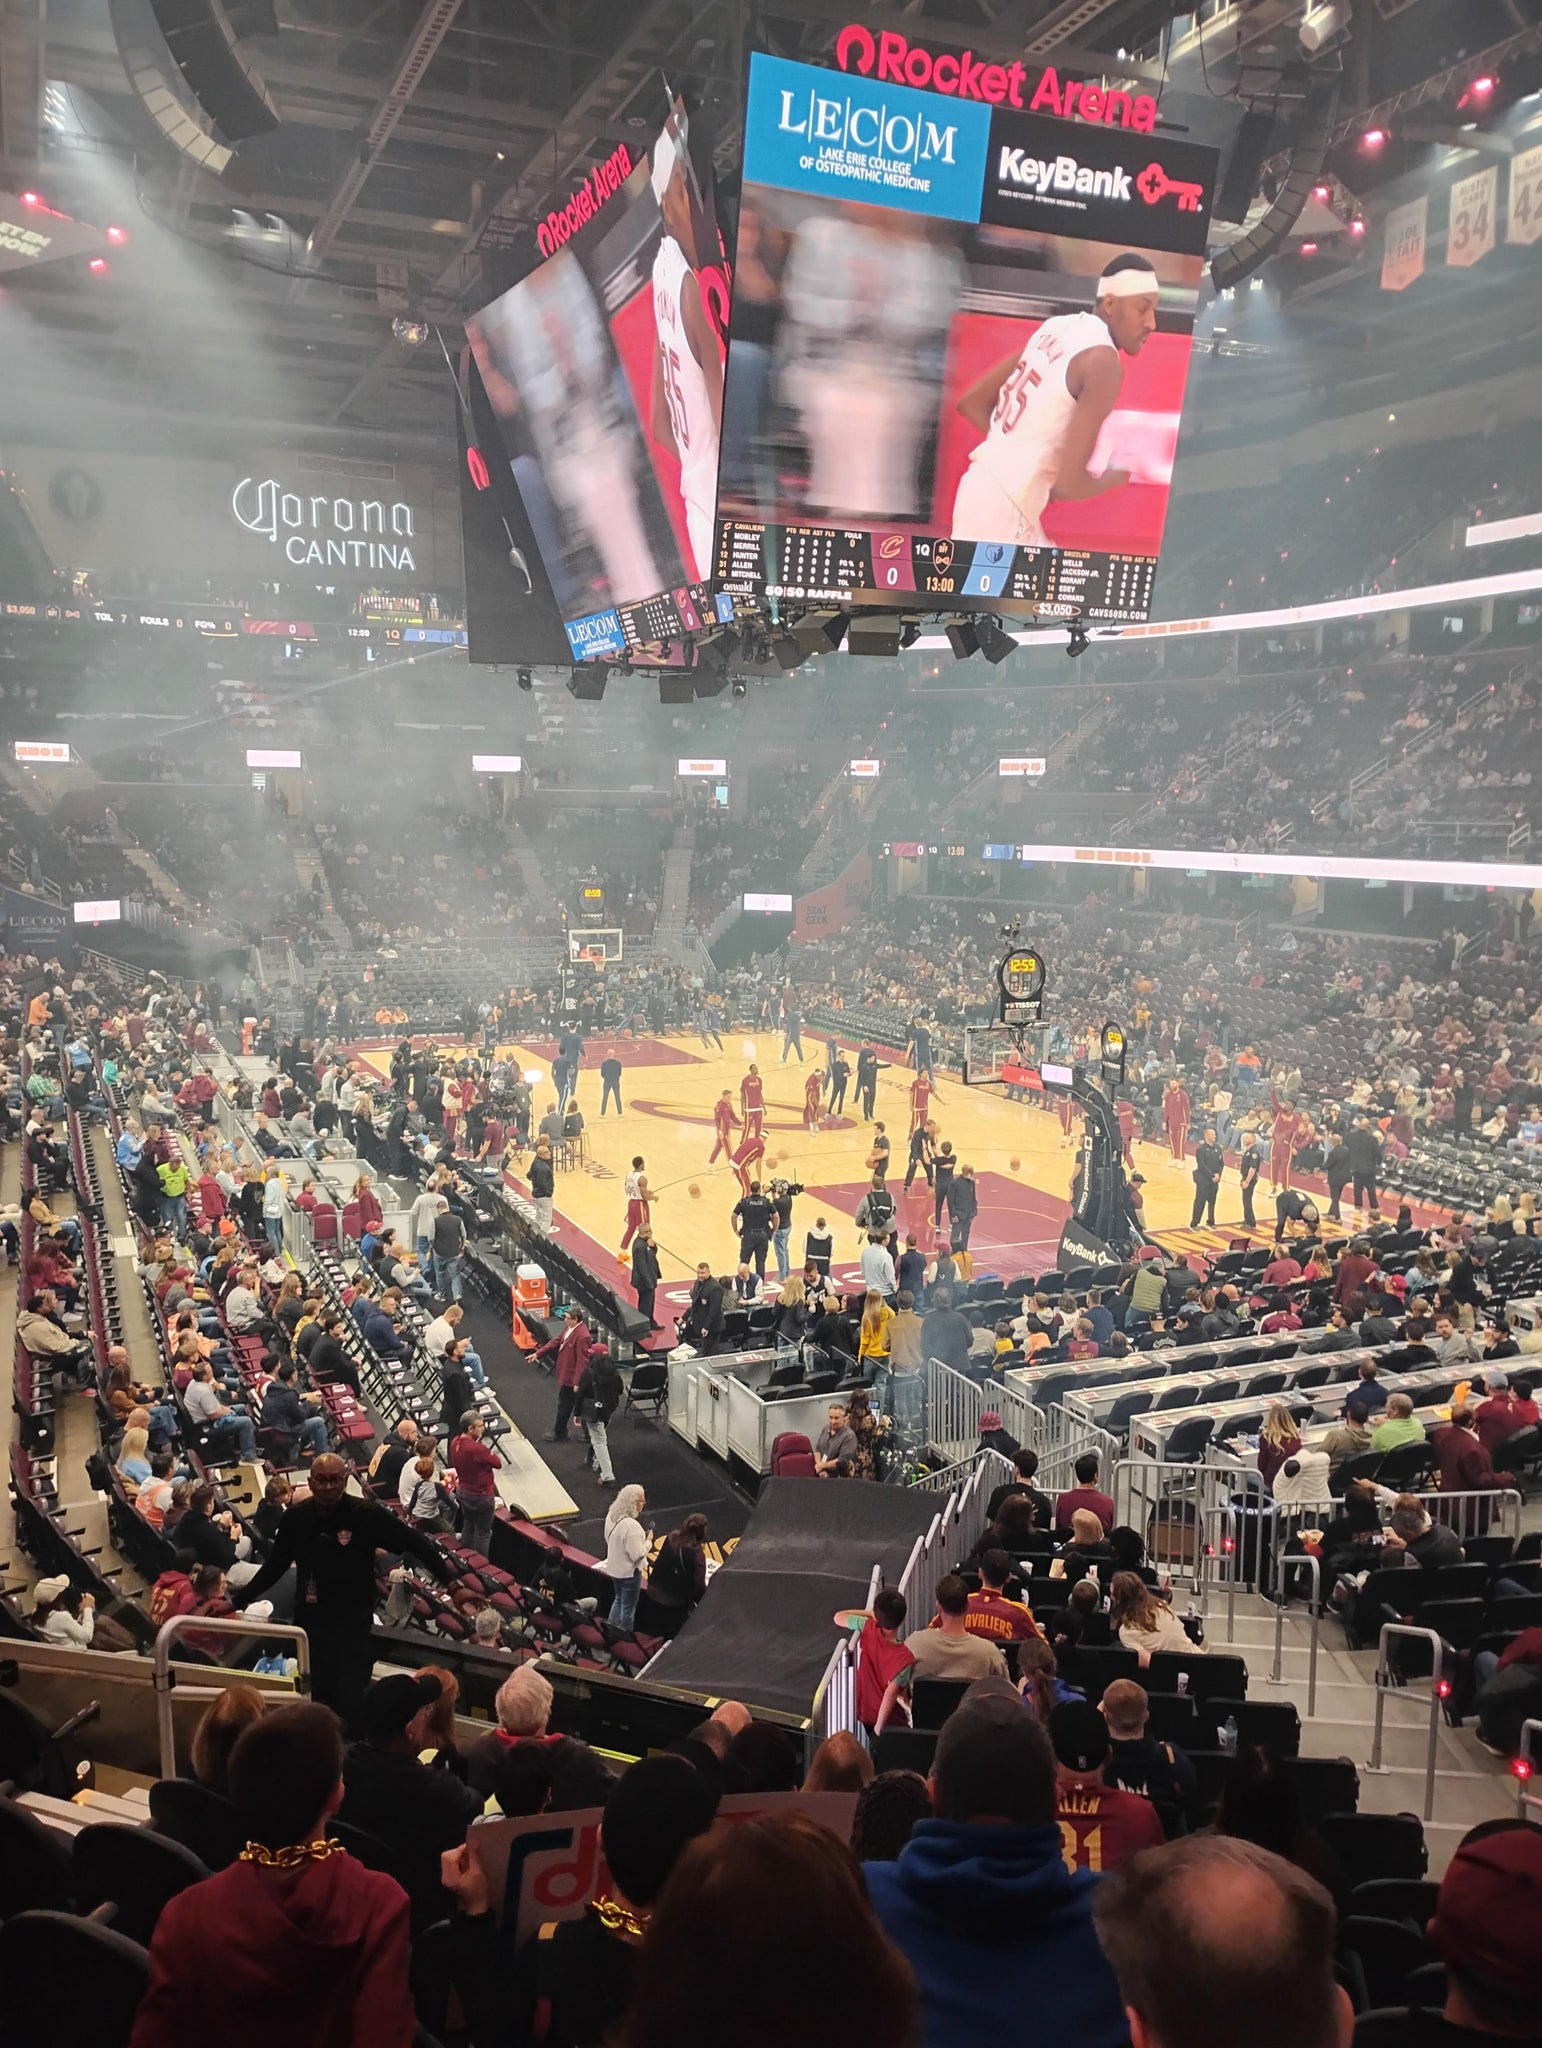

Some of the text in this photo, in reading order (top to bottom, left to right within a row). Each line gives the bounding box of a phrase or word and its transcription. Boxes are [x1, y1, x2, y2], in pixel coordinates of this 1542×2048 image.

[878, 31, 1156, 133] Rocket Arena
[819, 146, 911, 176] LAKE ERIE COLLEGE
[799, 155, 930, 193] OF OSTEOPATHIC MEDICINE
[999, 145, 1133, 200] KeyBank
[547, 143, 632, 249] Rocket Arena
[1455, 202, 1488, 250] 34
[232, 477, 413, 542] Corona
[734, 523, 766, 532] CAVALIERS
[786, 527, 797, 535] PTS
[799, 528, 810, 536] REB
[812, 529, 823, 537] AST
[844, 532, 863, 540] FOULS
[734, 532, 761, 542] MOBLEY
[786, 537, 791, 545] 0
[800, 538, 805, 546] 0
[813, 538, 818, 546] 0
[826, 540, 831, 548] 0
[849, 539, 856, 548] 0
[286, 536, 416, 571] CANTINA
[722, 541, 831, 557] 5 MERRILL 0 0 0 0
[915, 544, 930, 556] 1Q
[1023, 547, 1041, 555] FOULS
[1063, 550, 1091, 559] GRIZZLIES
[720, 551, 830, 566] 12 HUNTER 0 0 0 0
[839, 559, 848, 567] FG
[1028, 554, 1034, 562] 0
[719, 560, 829, 576] 31 ALLEN 0 0 0 0
[838, 569, 849, 577] 3PT
[1062, 559, 1083, 568] WELLS
[1110, 563, 1115, 571] 0
[1124, 564, 1129, 572] 0
[1135, 565, 1140, 573] 0
[1147, 566, 1153, 574] 0
[718, 569, 828, 584] 45 MITCHELL 0 0 0 0
[887, 567, 898, 585] 0
[1015, 573, 1024, 581] FG
[1060, 568, 1090, 577] JACKSON
[1090, 570, 1100, 578] JR.
[1108, 571, 1114, 579] 0
[1122, 572, 1128, 580] 0
[1133, 573, 1138, 581] 0
[1146, 574, 1151, 582] 0
[723, 580, 754, 593] oswald
[837, 579, 849, 587] TOL
[926, 576, 954, 593] 13:00
[979, 575, 991, 593] 0
[1060, 577, 1086, 585] MORANT
[1107, 580, 1112, 588] 0
[1121, 581, 1126, 589] 0
[1132, 582, 1137, 590] 0
[1145, 582, 1150, 590] 0
[807, 589, 852, 600] RAFFLE
[1013, 590, 1024, 598] TOL
[1059, 585, 1076, 593] EDEY
[1106, 588, 1111, 596] 0
[1120, 589, 1125, 597] 0
[1131, 590, 1136, 598] 0
[1144, 591, 1149, 599] 0
[1057, 594, 1085, 603] COWARD
[1105, 597, 1110, 605] 0
[1119, 598, 1124, 606] 0
[1130, 598, 1135, 606] 0
[1142, 599, 1148, 607] 0
[1039, 602, 1073, 616] $3,050
[1089, 608, 1147, 621] CAVS5050.COM
[94, 612, 127, 624] TOL 7
[140, 616, 183, 628] FOULS 0
[225, 621, 231, 631] 0
[289, 624, 297, 634] 0
[385, 629, 400, 640] 1Q
[418, 630, 425, 640] 0
[917, 845, 924, 855] 0
[929, 846, 937, 854] 1Q
[986, 847, 992, 857] 0
[806, 905, 827, 916] SEAT
[805, 915, 828, 925] GEEK
[1009, 958, 1036, 973] 12:59
[1014, 1001, 1041, 1009] TISSOT
[1077, 1150, 1091, 1214] Cleveland Clinic
[1062, 1236, 1098, 1263] KeyBank
[965, 1613, 1013, 1640] AVALIERS
[1055, 1820, 1102, 1876] 31
